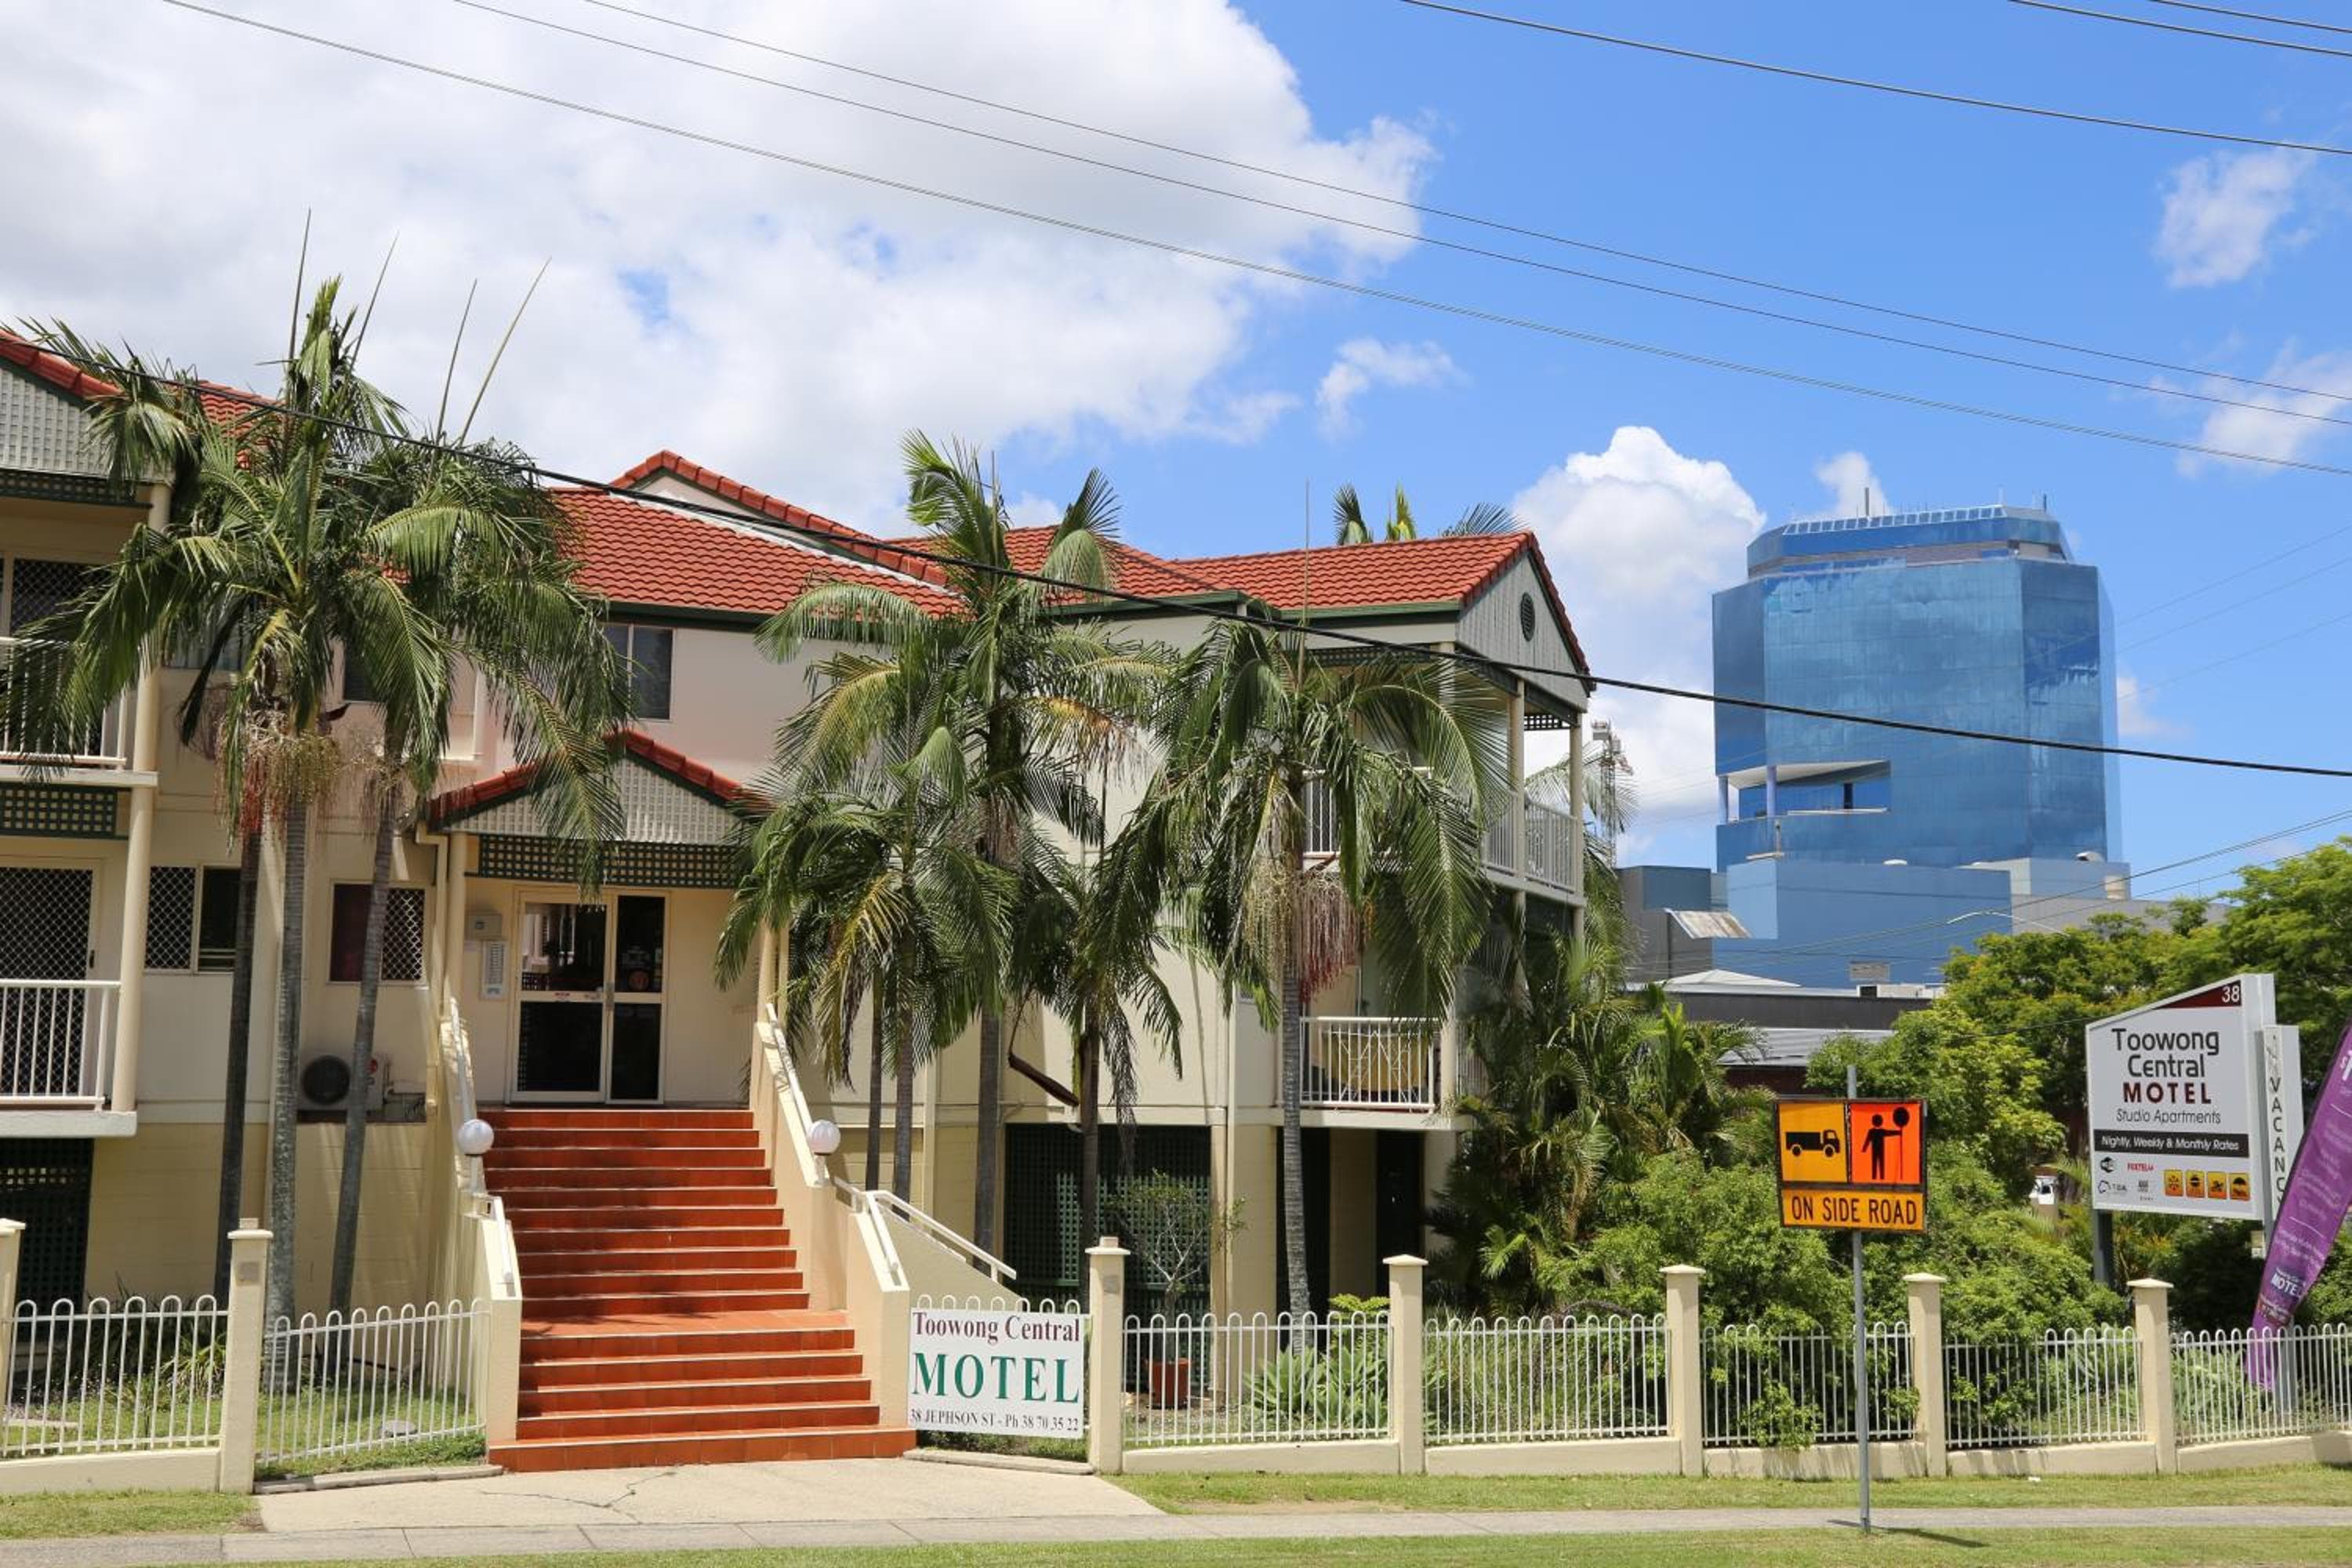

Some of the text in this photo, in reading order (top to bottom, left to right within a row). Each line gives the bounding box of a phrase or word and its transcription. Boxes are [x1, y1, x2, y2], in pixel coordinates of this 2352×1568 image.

[2221, 985, 2240, 1003] 38
[2111, 1028, 2220, 1056] Toowong
[2127, 1053, 2205, 1078] Central
[2122, 1081, 2212, 1105] MOTEL
[2117, 1107, 2221, 1125] Studio Apartments
[2133, 1135, 2165, 1150] Weekly
[2166, 1137, 2173, 1149] &
[2176, 1138, 2212, 1151] Monthly
[2213, 1139, 2239, 1150] Rates
[1791, 1196, 1917, 1225] ON SIDE ROAD
[912, 1312, 1080, 1345] Toowong Central
[911, 1352, 1080, 1404] MOTEL
[910, 1409, 922, 1423] 38
[924, 1410, 978, 1426] JEPHSON
[981, 1412, 996, 1427] ST
[1005, 1414, 1018, 1428] Ph
[1022, 1414, 1034, 1429] 38
[1036, 1415, 1048, 1430] 70
[1051, 1417, 1064, 1431] 35
[1067, 1417, 1079, 1431] 22
